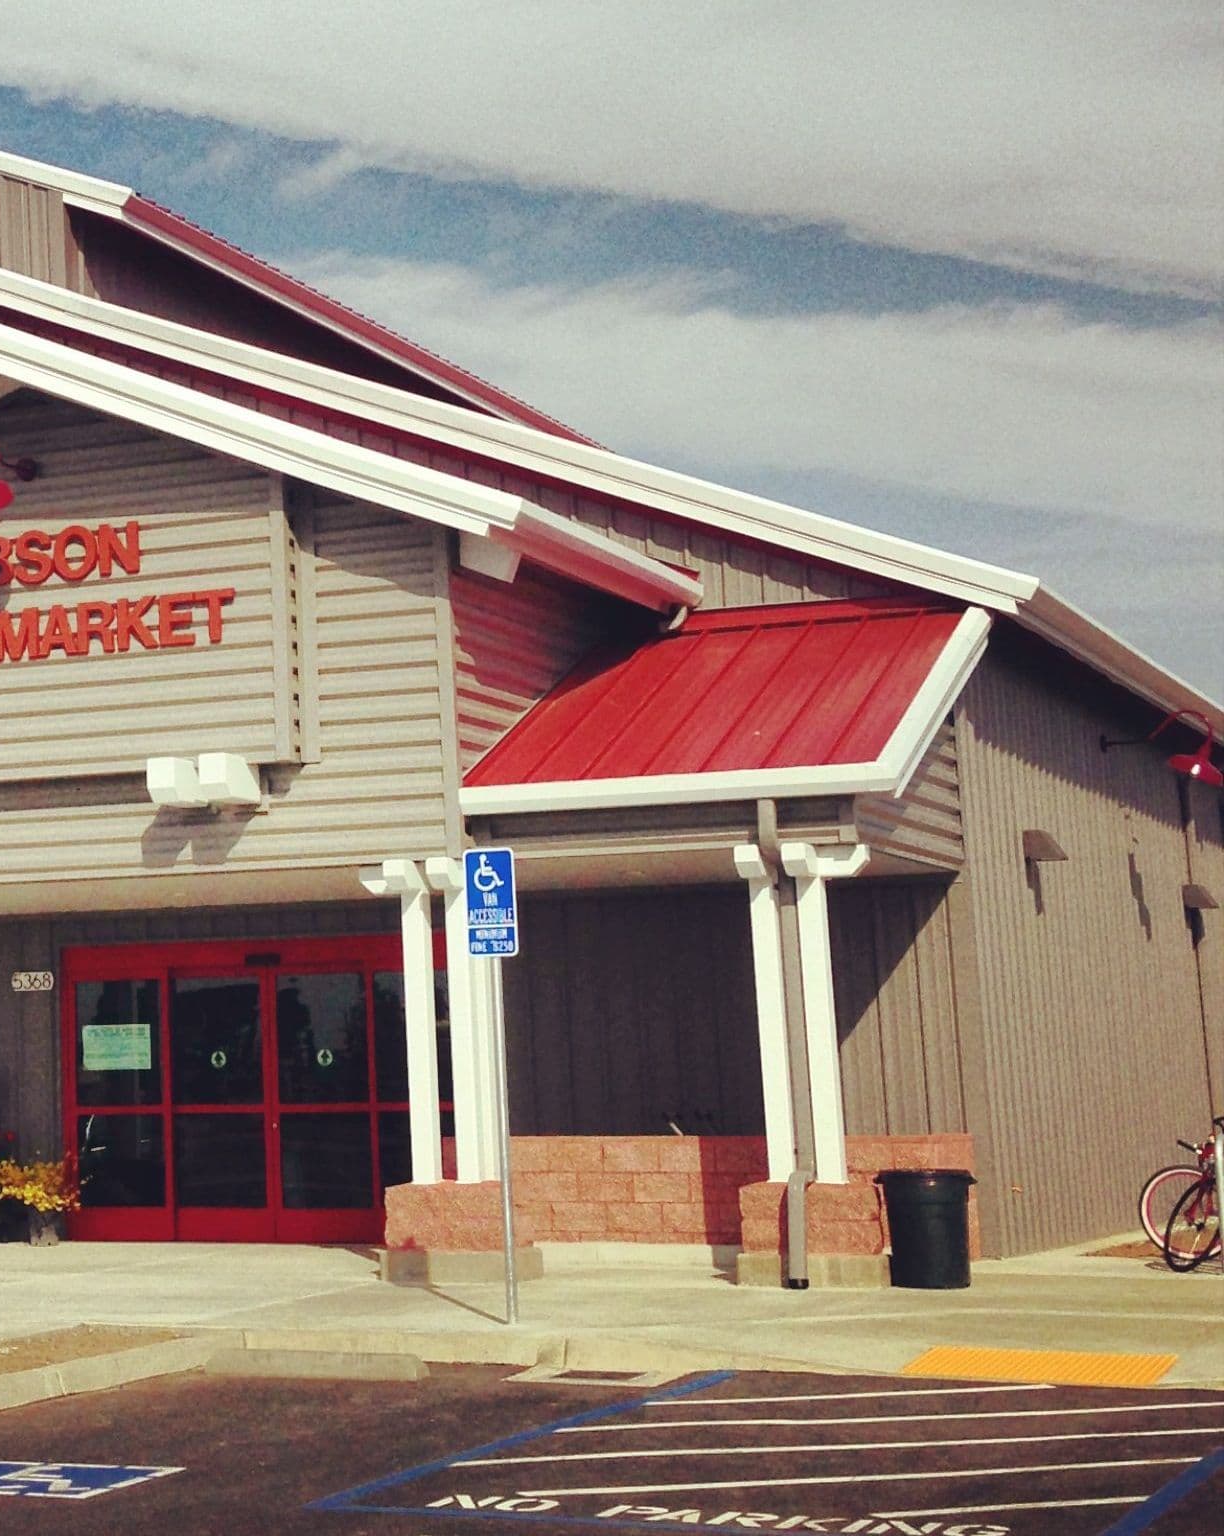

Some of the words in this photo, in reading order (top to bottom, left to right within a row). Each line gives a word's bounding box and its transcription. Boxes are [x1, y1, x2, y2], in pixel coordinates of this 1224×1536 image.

[13, 973, 51, 989] 5368
[426, 1494, 560, 1512] NO
[595, 1505, 1010, 1536] PARKING
